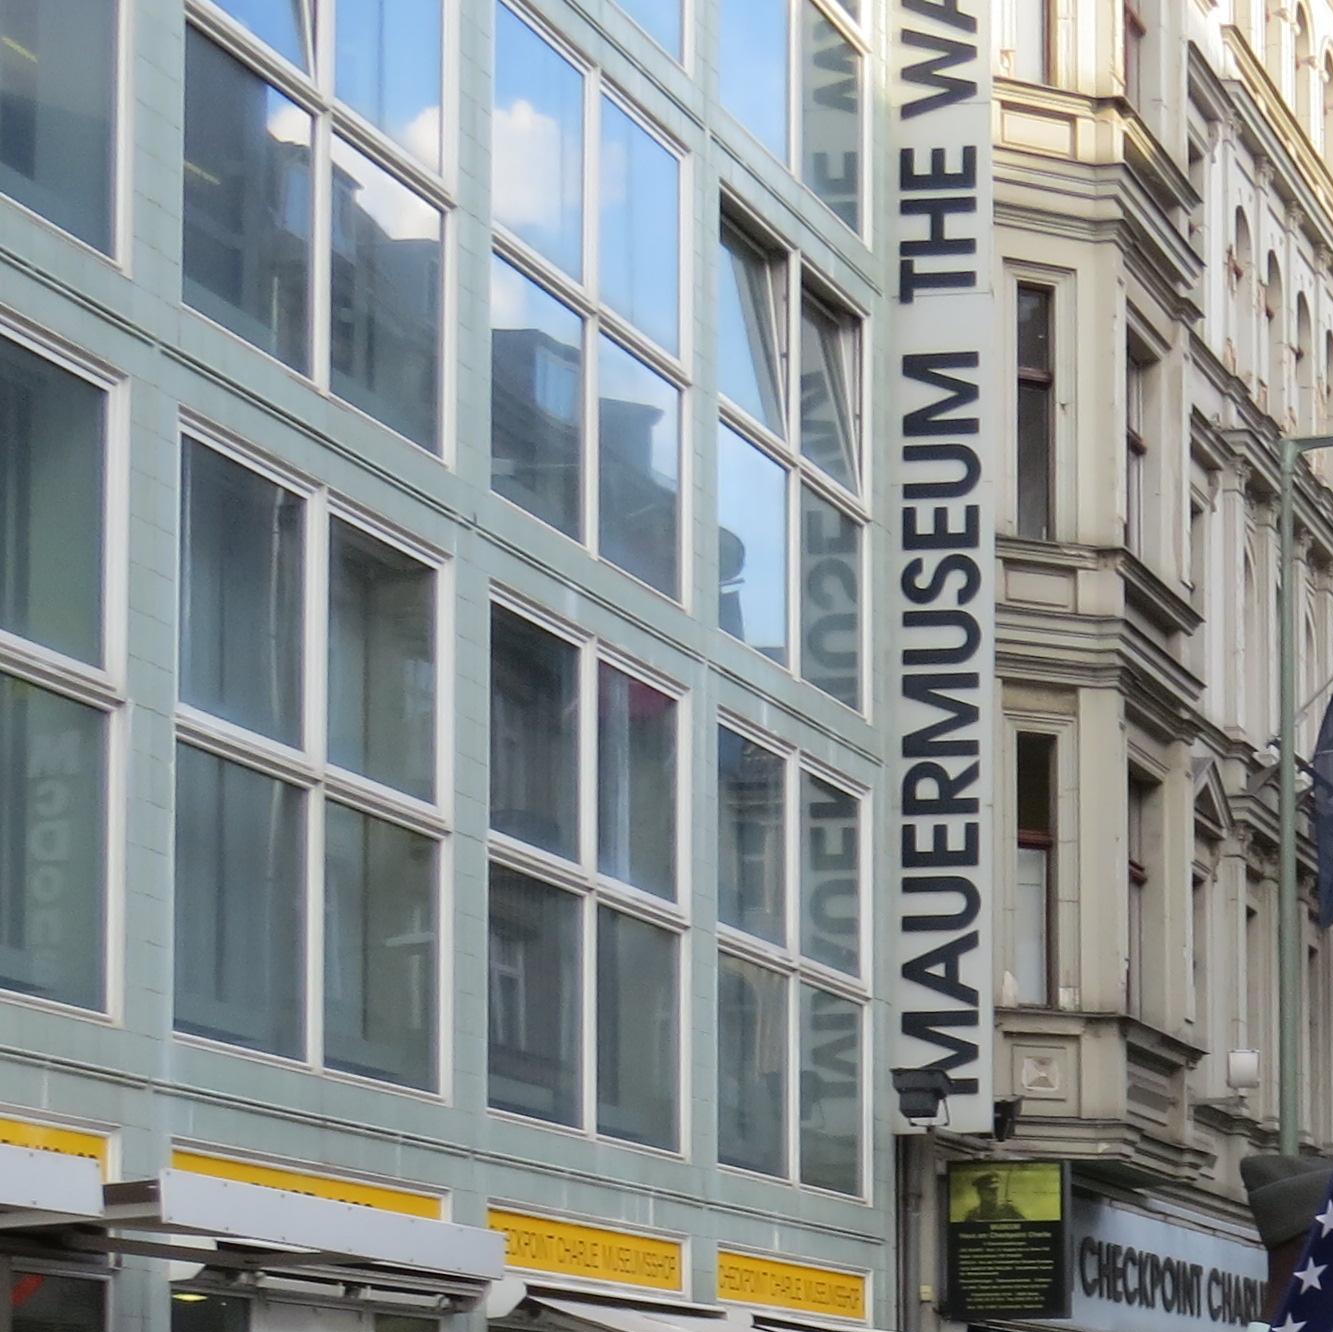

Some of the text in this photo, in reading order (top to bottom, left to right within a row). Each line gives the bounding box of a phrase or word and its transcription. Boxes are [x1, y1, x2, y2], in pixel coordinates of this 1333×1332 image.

[900, 145, 977, 304] THE
[900, 351, 981, 1095] MAUERMUSEUM
[1079, 1236, 1203, 1319] CHECKPOINT
